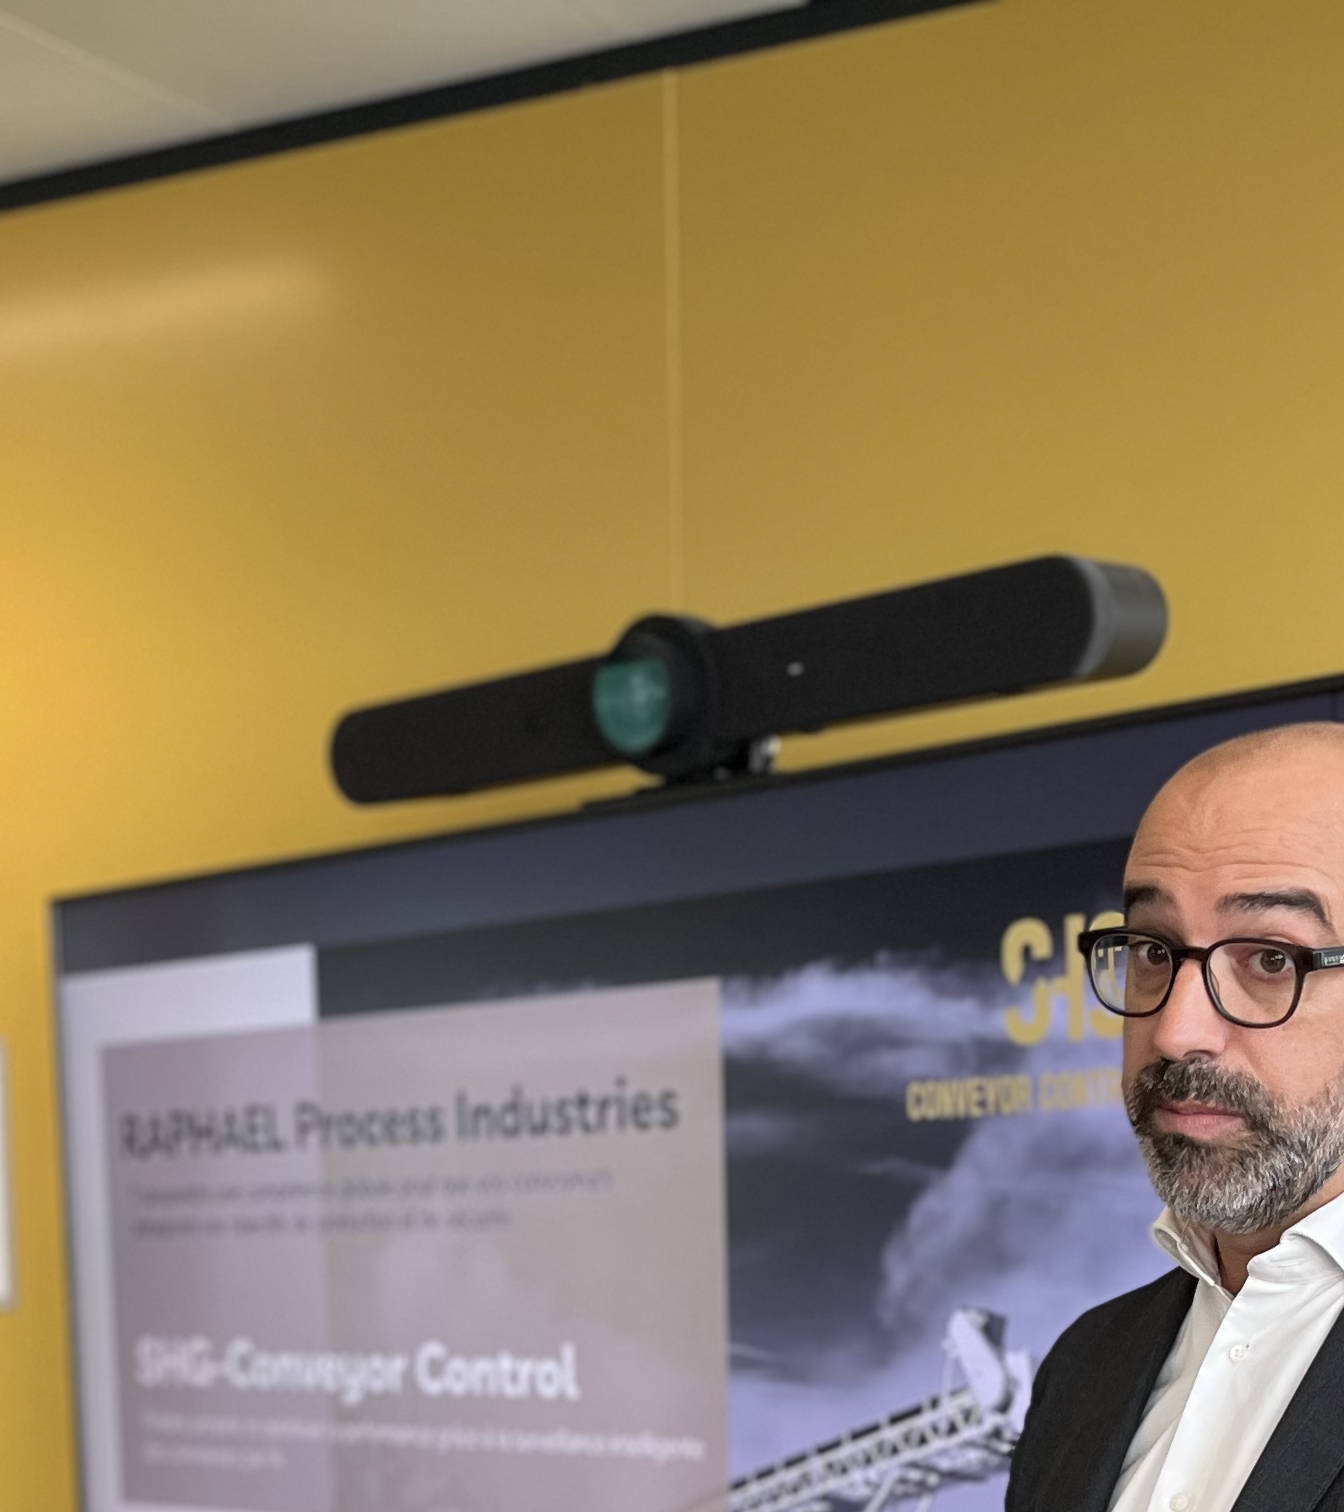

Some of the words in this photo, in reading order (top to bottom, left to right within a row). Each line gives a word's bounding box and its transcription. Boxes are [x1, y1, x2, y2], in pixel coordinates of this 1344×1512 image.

[118, 1099, 288, 1161] RAPHAEL
[296, 1098, 445, 1151] Process
[456, 1076, 680, 1142] Industries
[906, 1073, 1032, 1122] CONVEYOR
[415, 1338, 580, 1400] Control
